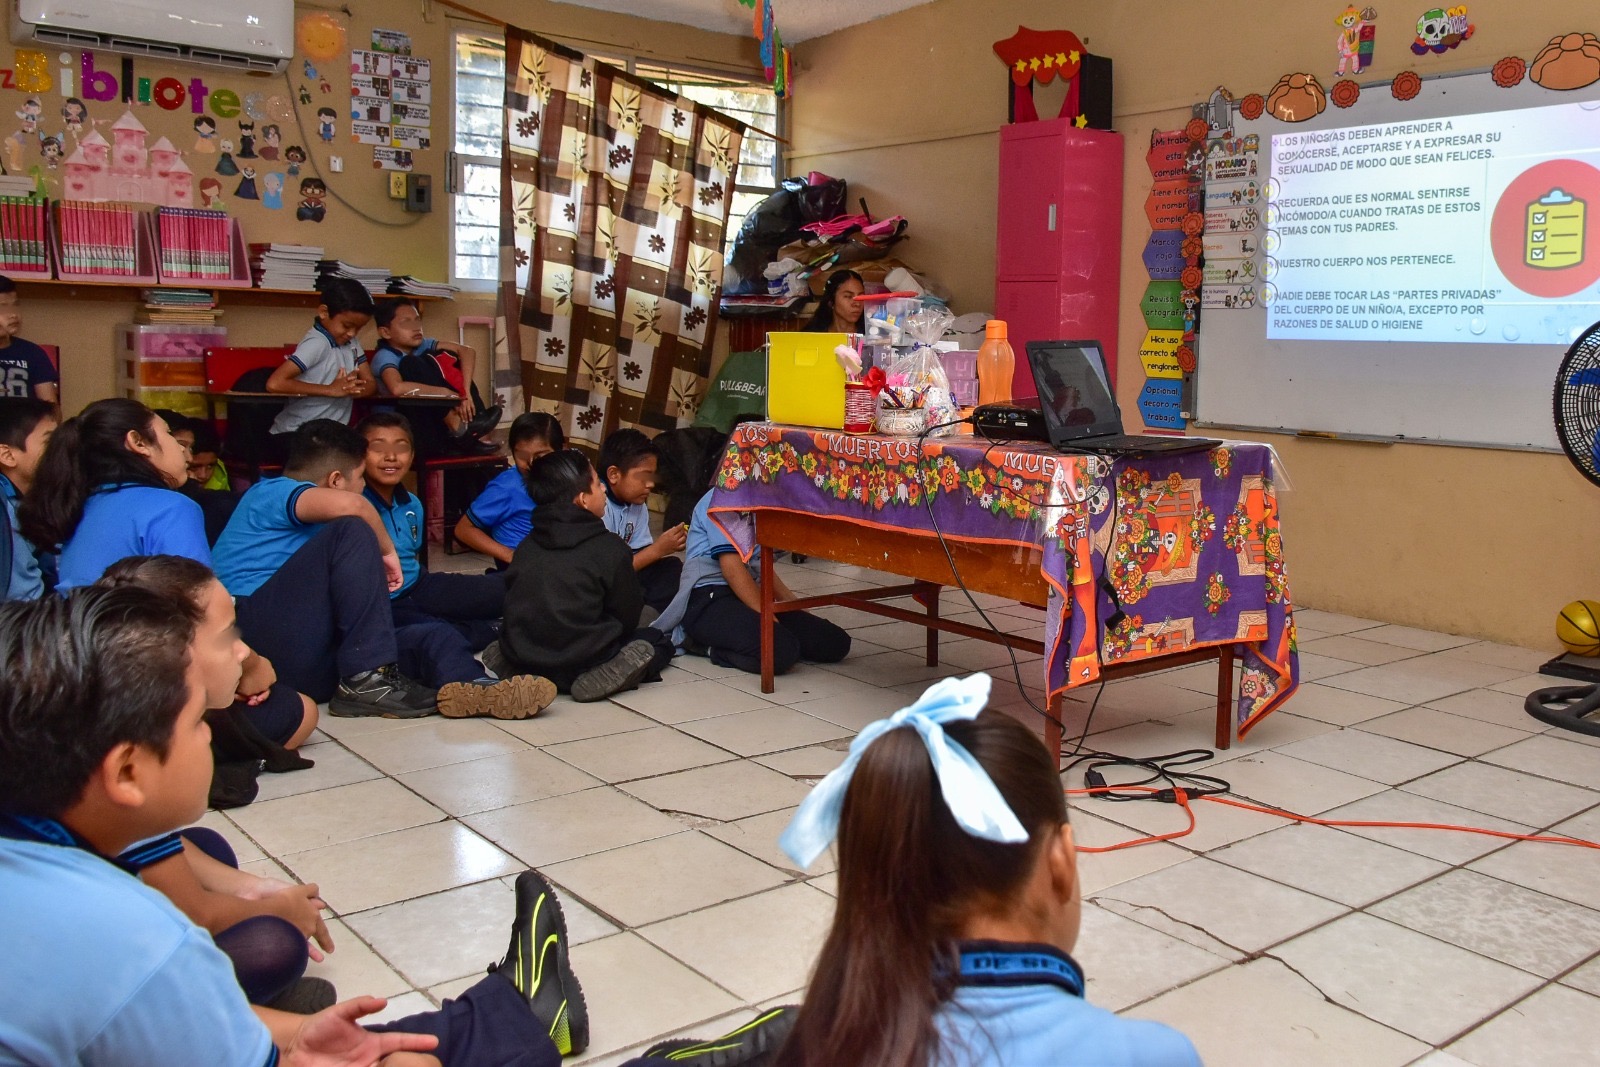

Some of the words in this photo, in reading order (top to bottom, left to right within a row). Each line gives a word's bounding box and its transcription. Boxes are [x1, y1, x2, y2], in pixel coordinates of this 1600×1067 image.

[247, 15, 259, 25] 24
[15, 49, 297, 122] Biblioteca
[1279, 137, 1298, 147] LOS
[1301, 131, 1345, 145] NIÑOS/AS
[1348, 127, 1382, 140] DEBEN
[1384, 122, 1442, 137] APRENDER
[1445, 121, 1453, 130] A
[1168, 136, 1189, 145] traba
[1278, 148, 1340, 161] CONOCERSE,
[1342, 141, 1402, 155] ACEPTARSE
[1405, 140, 1412, 149] Y
[1414, 139, 1421, 149] A
[1424, 134, 1483, 148] EXPRESAR
[1485, 132, 1501, 143] SU
[1215, 158, 1247, 170] HORARIO
[1278, 162, 1338, 175] SEXUALIDAD
[1340, 160, 1353, 170] DE
[1356, 157, 1387, 168] MODO
[1389, 155, 1411, 167] QUE
[1414, 153, 1443, 164] SEAN
[1446, 149, 1495, 162] FELICES.
[1152, 188, 1172, 197] Tiene
[1278, 196, 1329, 208] RECUERDA
[1332, 195, 1353, 205] QUE
[1355, 193, 1368, 203] ES
[1370, 191, 1415, 202] NORMAL
[1417, 187, 1470, 200] SENTIRSE
[1161, 202, 1187, 210] nombr
[1275, 210, 1337, 222] INCÓMODO/A
[1339, 207, 1382, 219] CUANDO
[1385, 205, 1425, 216] TRATAS
[1427, 204, 1442, 214] DE
[1445, 202, 1481, 213] ESTOS
[1155, 215, 1184, 224] comple
[1277, 225, 1308, 236] TEMAS
[1310, 225, 1331, 235] CON
[1334, 223, 1353, 233] TUS
[1355, 221, 1398, 232] PADRES.
[1155, 252, 1173, 261] rojo
[1275, 258, 1320, 268] NUESTRO
[1322, 257, 1364, 267] CUERPO
[1366, 256, 1388, 266] NOS
[1390, 254, 1456, 265] PERTENECE.
[1149, 295, 1174, 303] Reviso
[1273, 291, 1303, 300] NADIE
[1305, 291, 1331, 300] DEBE
[1334, 290, 1368, 300] TOCAR
[1371, 290, 1390, 300] LAS
[1274, 305, 1292, 314] DEL
[1294, 305, 1333, 314] CUERPO
[1336, 305, 1349, 314] DE
[1352, 305, 1366, 314] UN
[1368, 303, 1406, 316] NIÑO/A,
[1409, 305, 1458, 315] EXCEPTO
[1460, 305, 1484, 315] POR
[1274, 319, 1318, 329] RAZONES
[1320, 319, 1333, 329] DE
[1335, 319, 1369, 329] SALUD
[1371, 319, 1379, 329] O
[1381, 320, 1423, 330] HIGIENE
[1150, 336, 1165, 344] Hice
[1139, 349, 1168, 357] correcto
[1147, 363, 1180, 372] renglones
[1143, 400, 1169, 408] decoro
[1147, 413, 1176, 423] trabajo
[1003, 451, 1057, 477] MUE
